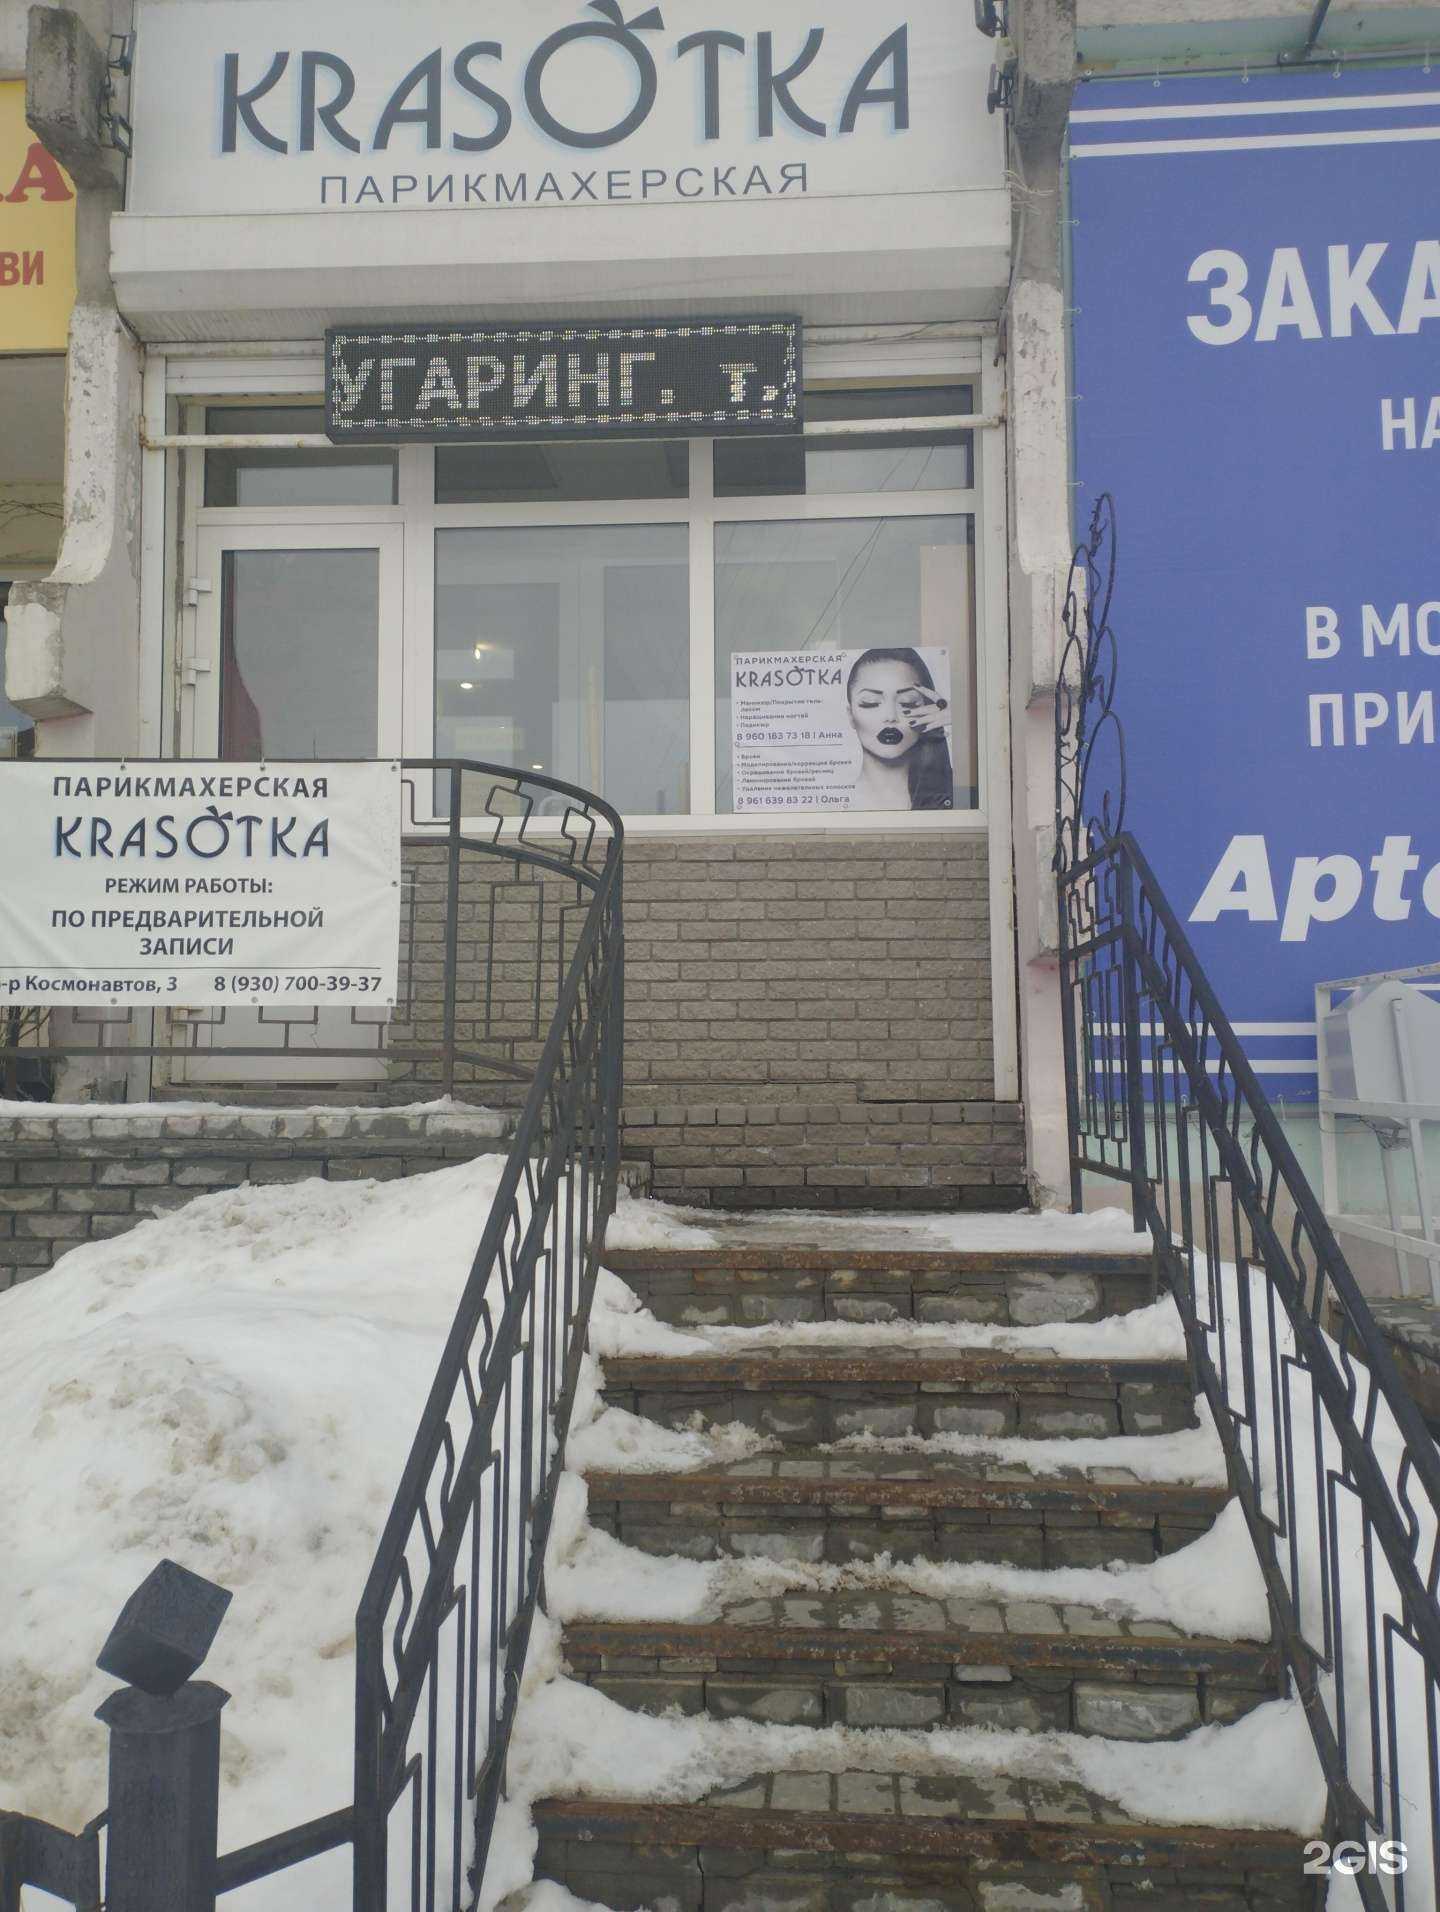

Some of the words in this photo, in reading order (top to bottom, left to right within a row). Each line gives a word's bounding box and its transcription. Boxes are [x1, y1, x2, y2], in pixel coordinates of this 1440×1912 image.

[221, 0, 909, 155] KRASOTKA
[320, 163, 808, 204] ПАРИКМАХЕРСКАЯ
[0, 250, 44, 286] ВИ
[1186, 240, 1440, 346] ЗАКА
[1306, 606, 1341, 659] В
[736, 655, 843, 665] ПАРИКМАХЕРСКАЯ
[736, 666, 842, 688] KRASOTKA
[1309, 690, 1435, 747] ПРИ
[745, 732, 765, 740] 960
[818, 731, 843, 739] Анна
[53, 776, 329, 798] ПАРИКМАХЕРСКАЯ
[738, 797, 745, 805] 8
[747, 796, 763, 805] 961
[766, 796, 783, 804] 639
[801, 795, 813, 803] 22
[821, 795, 850, 804] Ольга
[54, 805, 330, 859] KRASOTKA
[105, 878, 179, 894] РЕЖИМ
[184, 877, 273, 894] РАБОТЫ:
[1188, 834, 1440, 942] Apt
[52, 910, 85, 928] ПО
[92, 907, 324, 932] ПРЕДВАРИТЕЛЬНОЙ
[139, 937, 234, 956] ЗАПИСИ
[25, 975, 161, 994] Космонавтов,
[166, 976, 178, 992] 3
[214, 976, 226, 992] 8
[231, 975, 279, 994] (930)
[284, 976, 382, 992] 700-39-37
